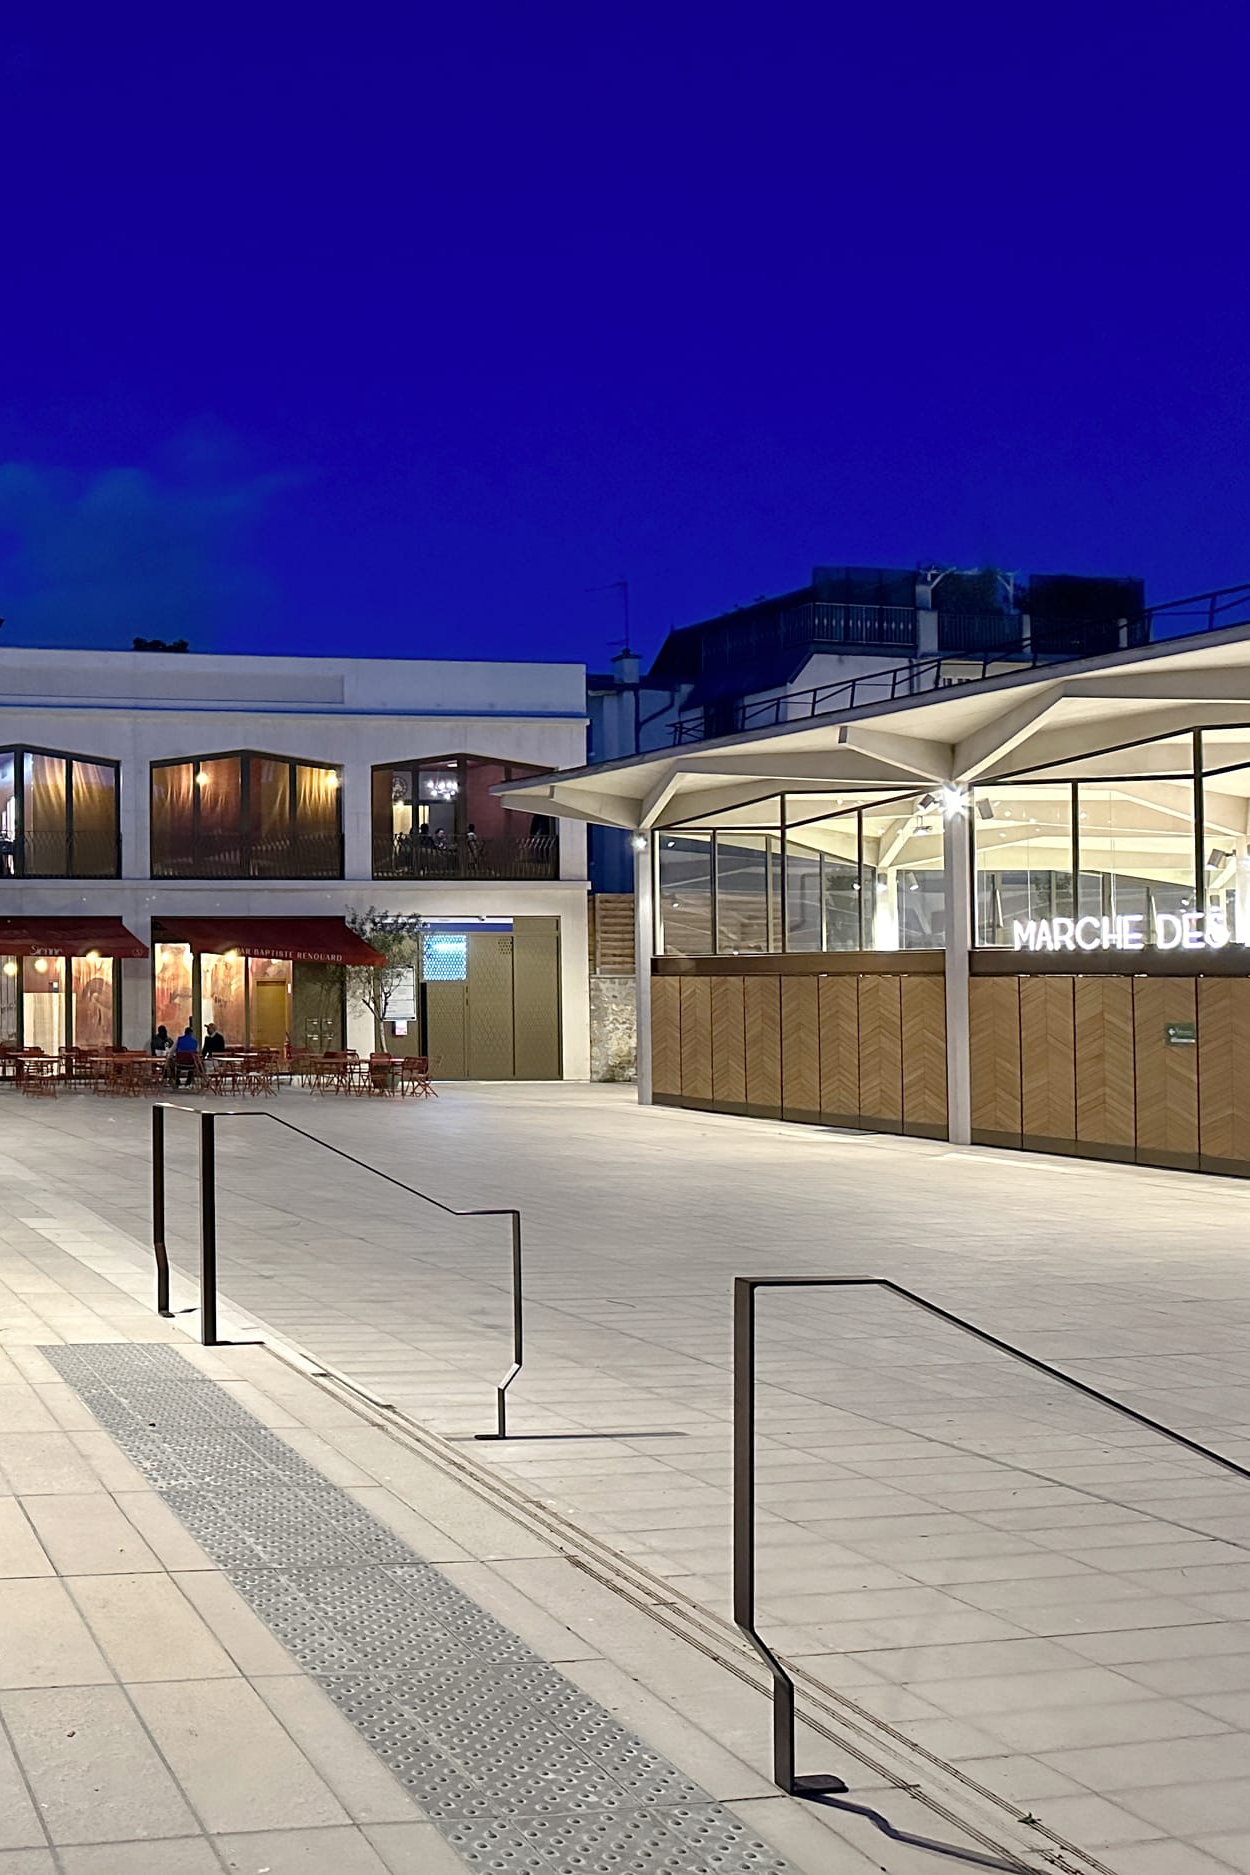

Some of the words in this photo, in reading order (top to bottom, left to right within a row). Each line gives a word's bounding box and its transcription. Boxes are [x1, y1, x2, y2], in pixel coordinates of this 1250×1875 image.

[1013, 914, 1145, 952] MARCHE
[254, 949, 293, 958] BAPTISTE
[297, 952, 343, 961] RENOUARD
